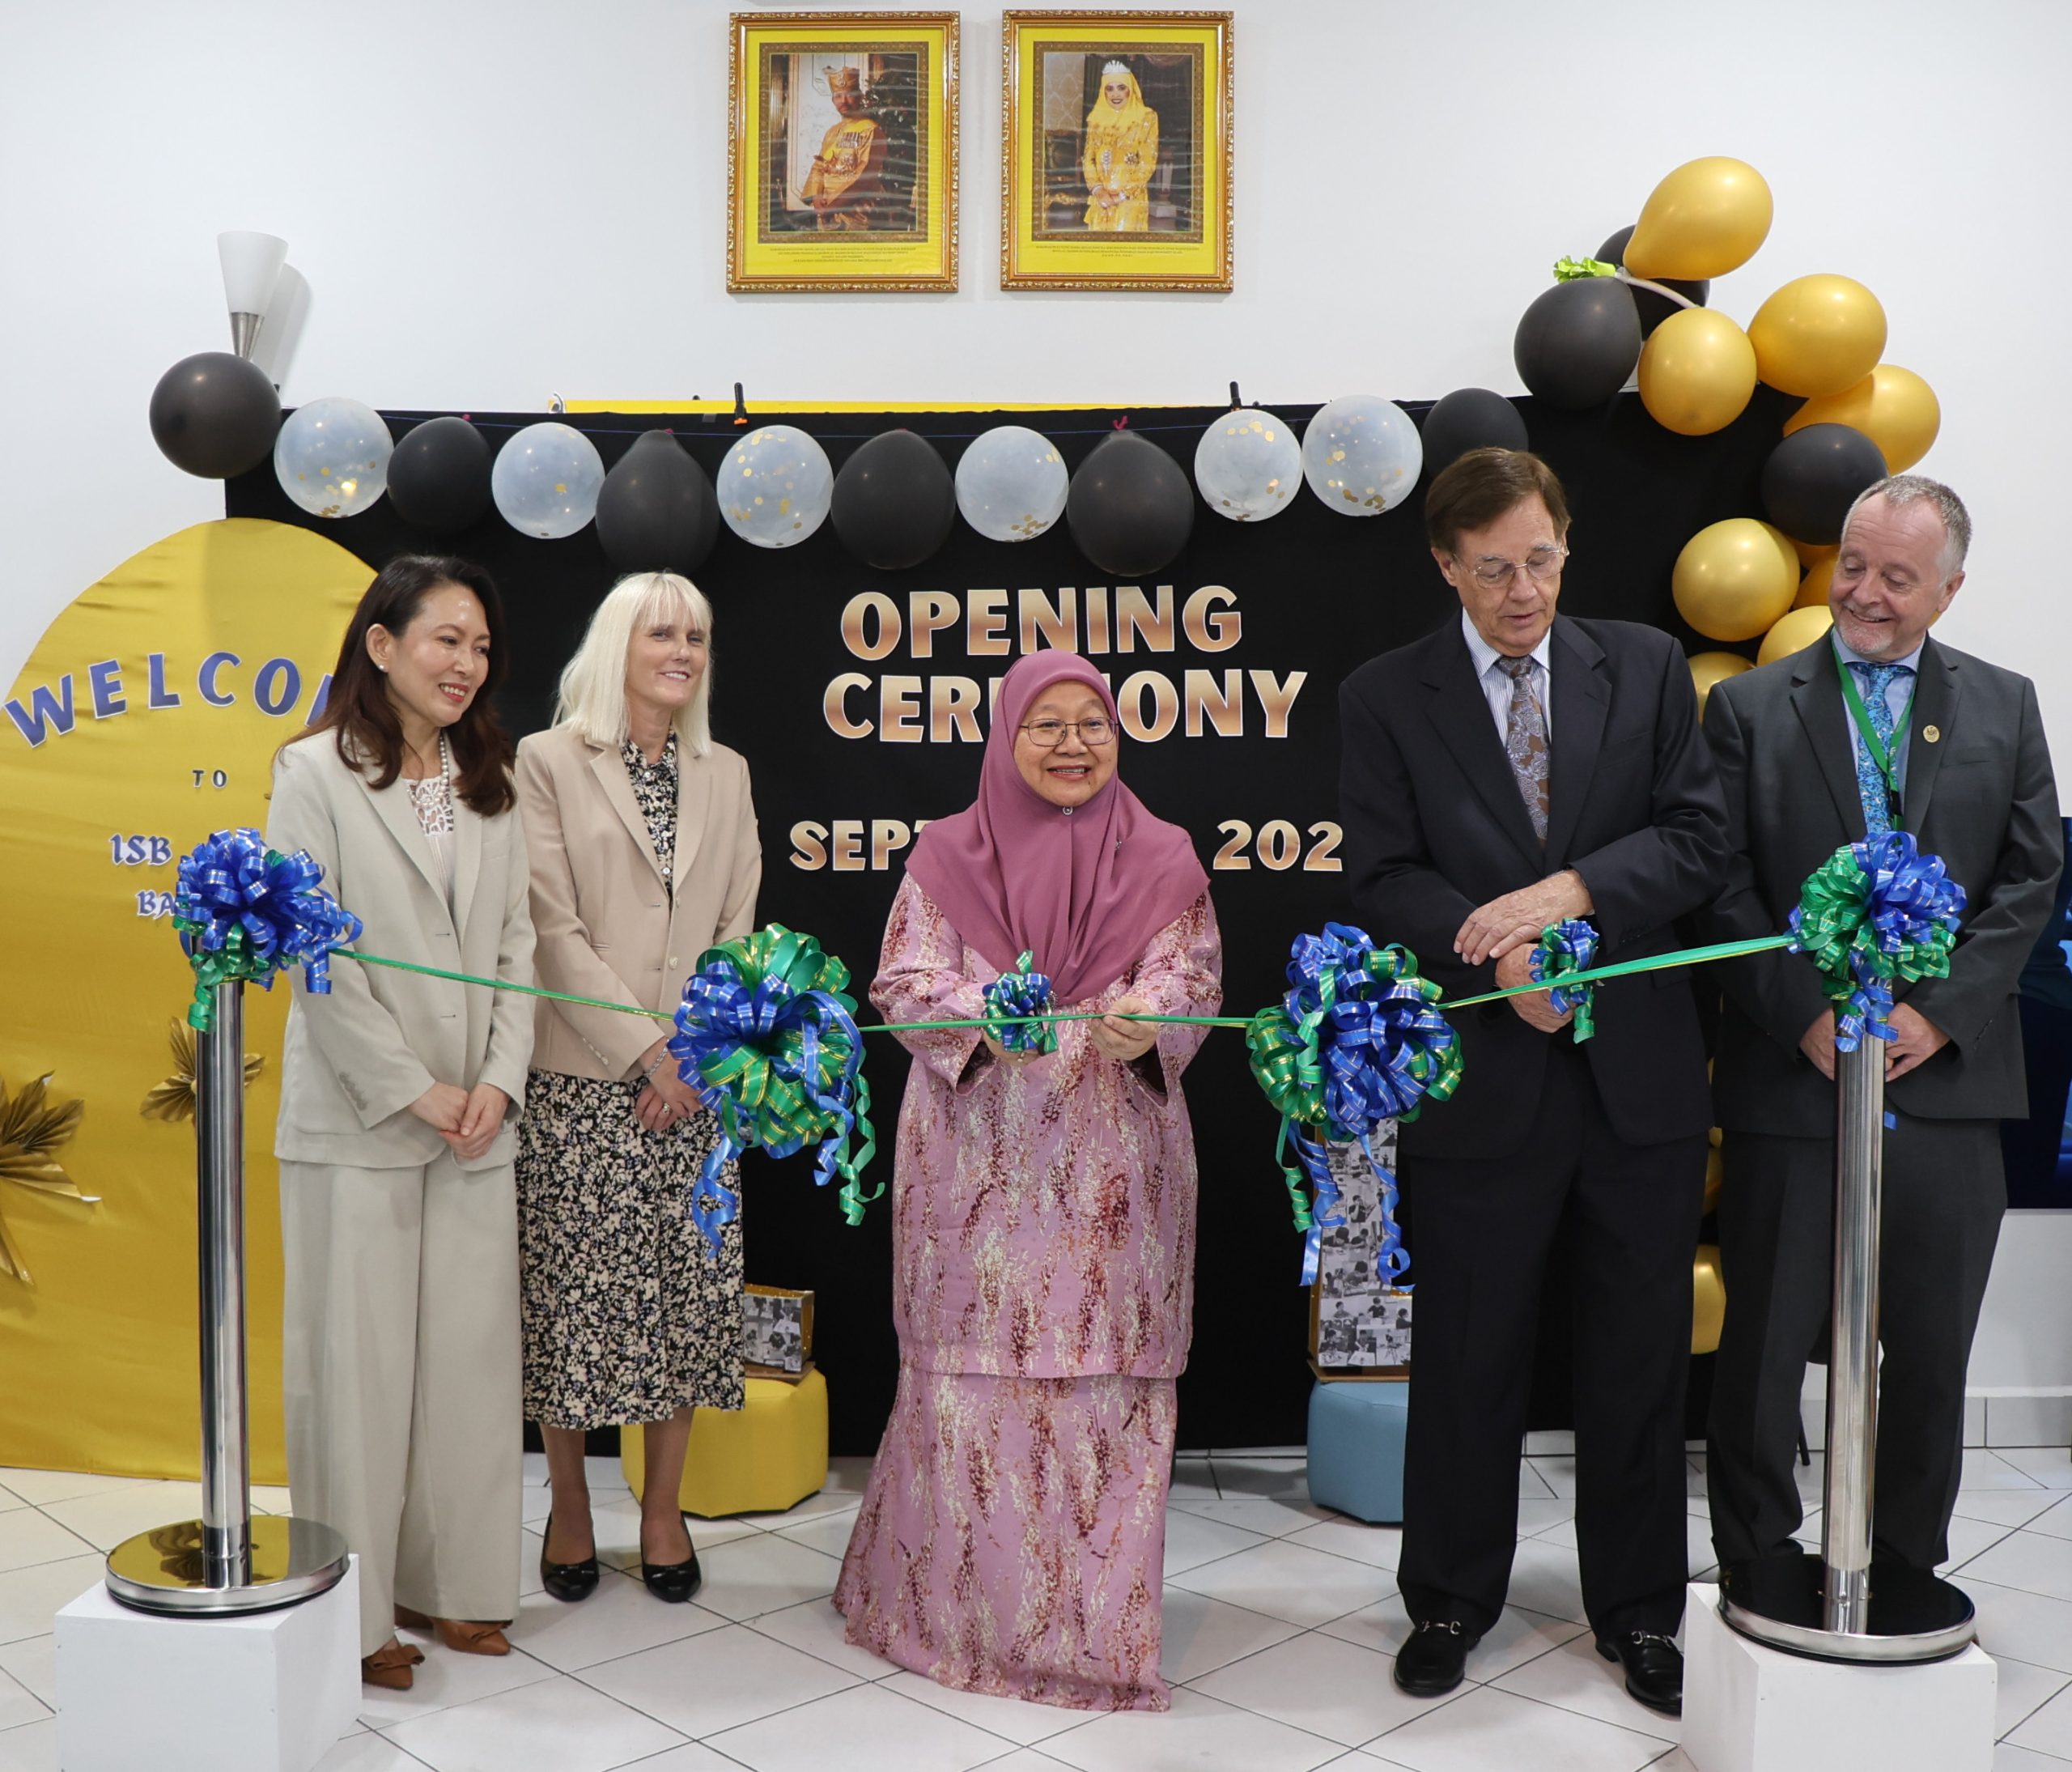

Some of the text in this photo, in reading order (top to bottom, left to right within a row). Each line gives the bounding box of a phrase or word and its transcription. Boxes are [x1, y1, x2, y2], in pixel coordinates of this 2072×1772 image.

[840, 584, 1242, 661] OPENING
[822, 669, 1308, 743] CERONY
[192, 769, 227, 789] TO
[109, 834, 172, 865] ISB
[1213, 819, 1344, 872] 202
